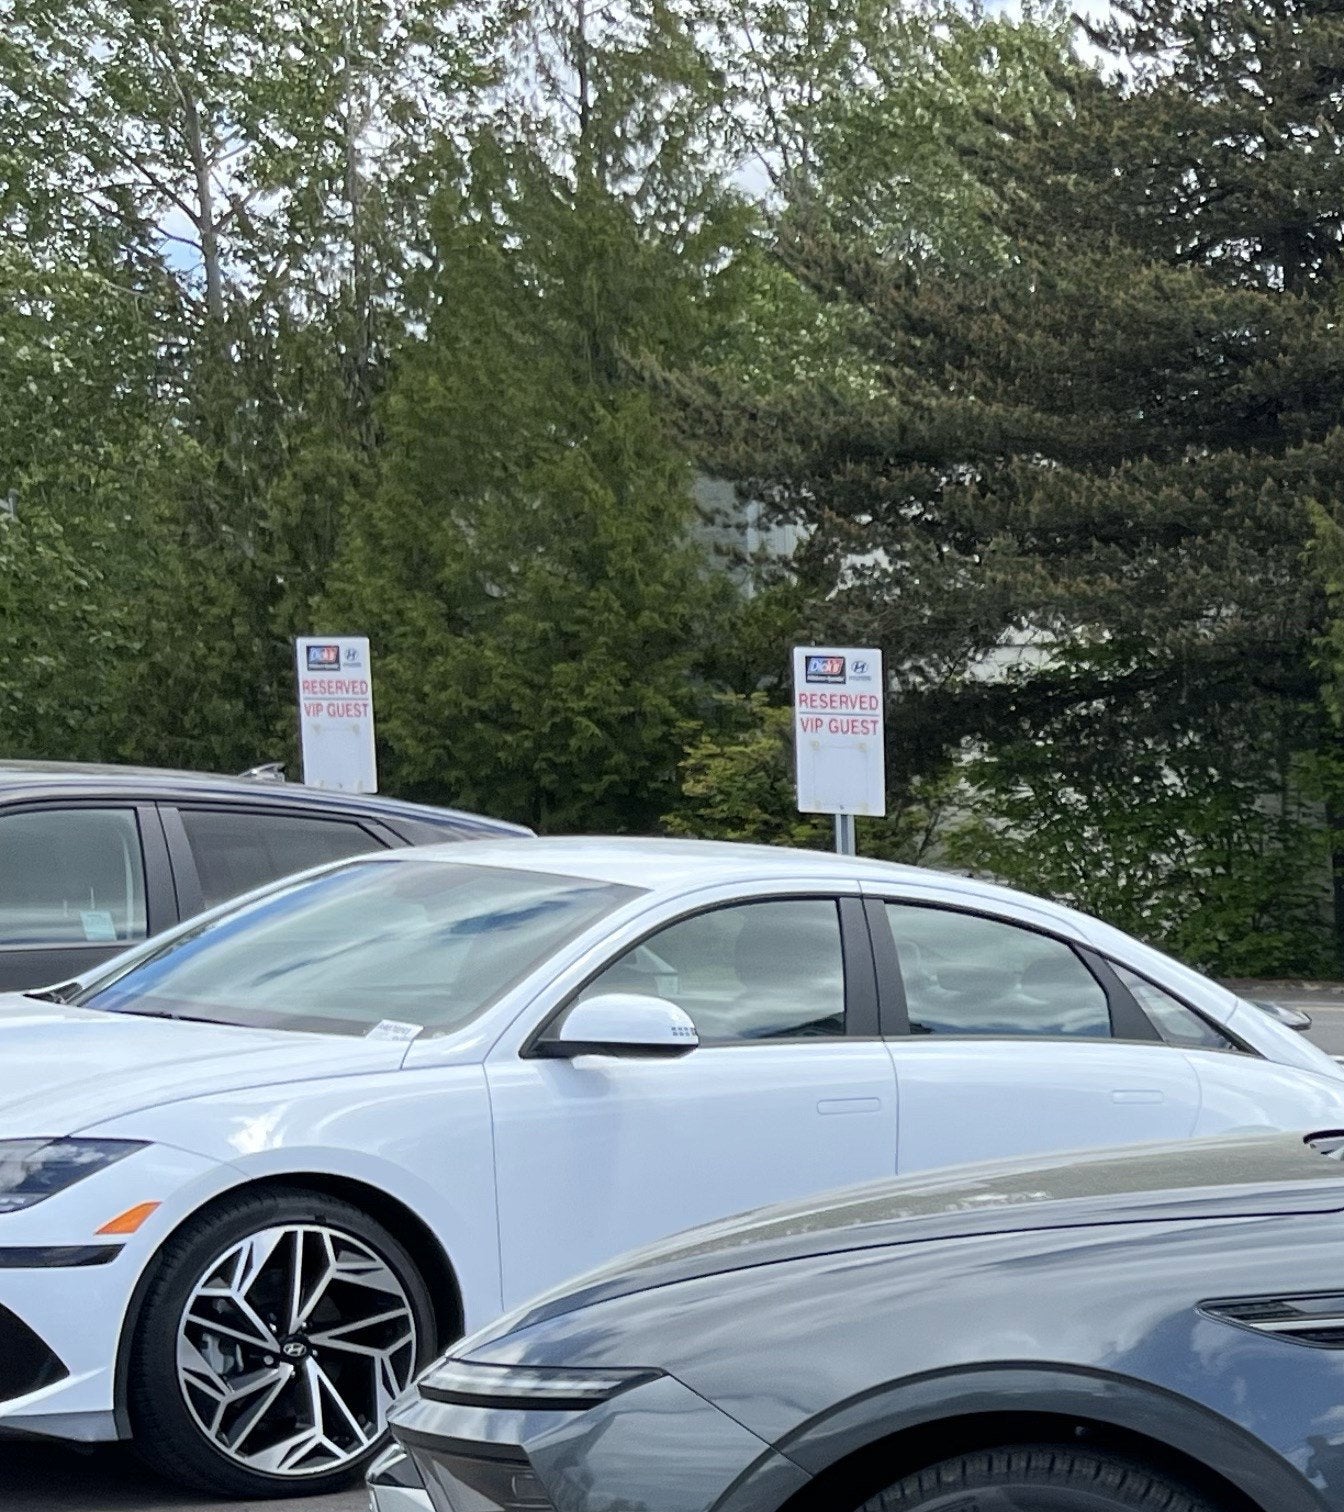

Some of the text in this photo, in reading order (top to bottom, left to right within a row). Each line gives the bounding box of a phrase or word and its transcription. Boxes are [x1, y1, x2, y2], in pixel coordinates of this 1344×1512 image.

[302, 680, 369, 695] RESERVED
[799, 692, 879, 710] RESERVED
[304, 702, 369, 718] VIP GUEST
[800, 718, 879, 735] VIP GUEST
